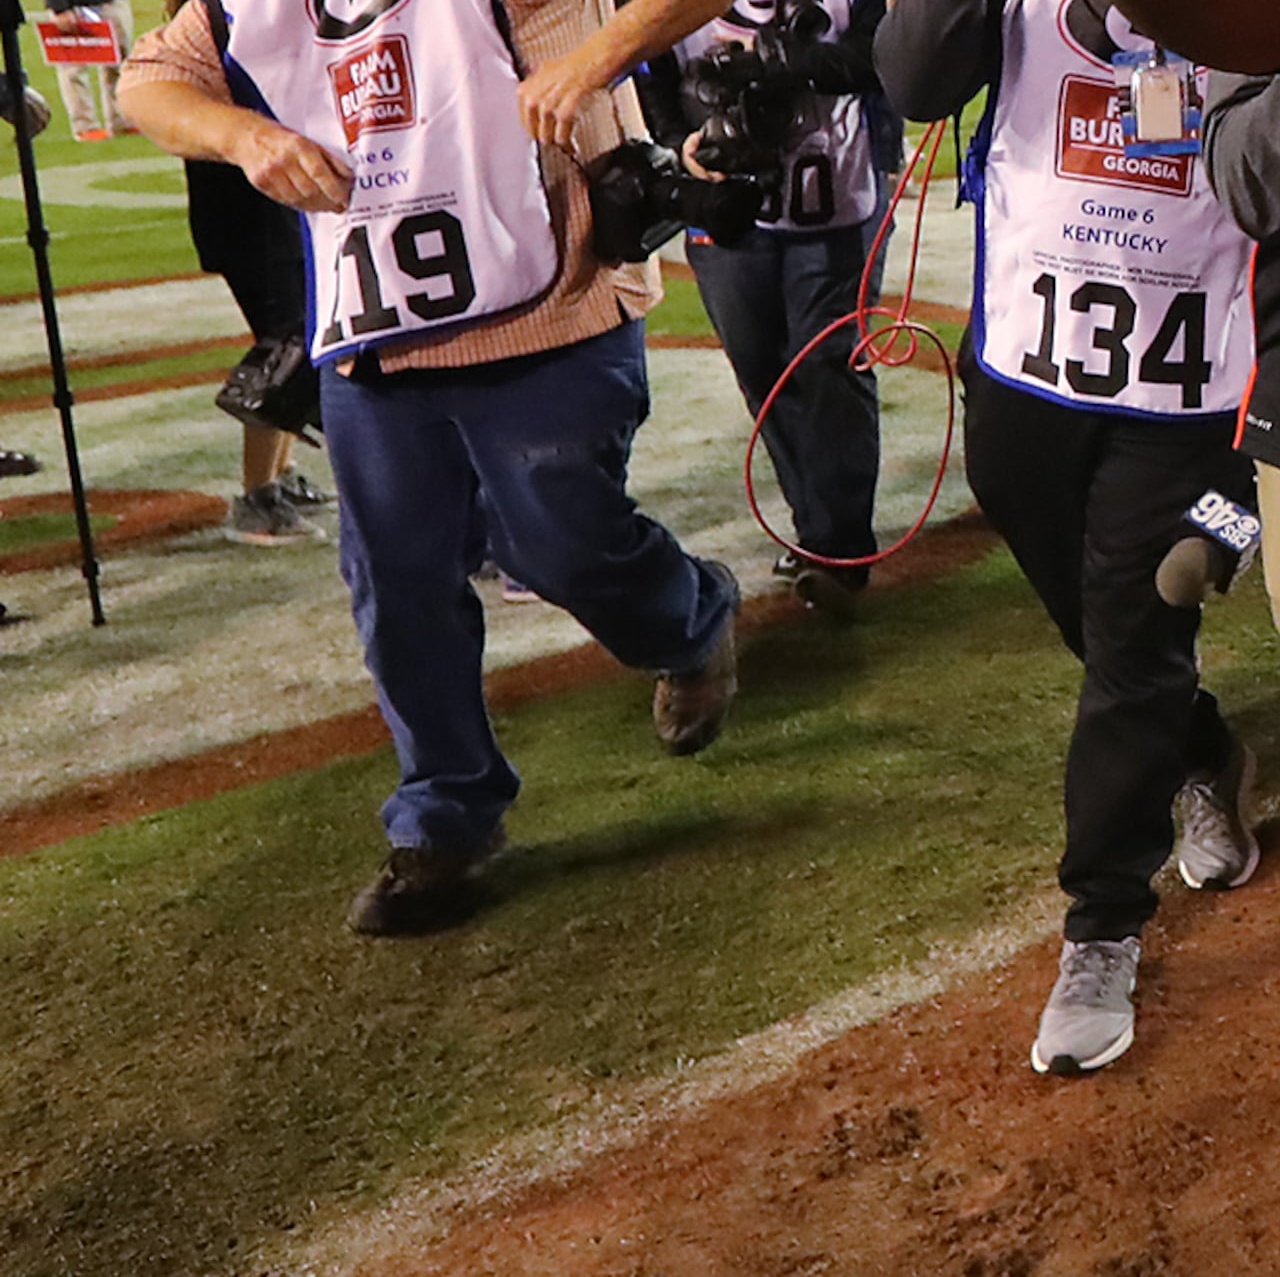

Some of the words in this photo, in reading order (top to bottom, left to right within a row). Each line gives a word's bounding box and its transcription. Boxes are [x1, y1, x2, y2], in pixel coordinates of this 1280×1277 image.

[382, 147, 394, 162] 6
[1103, 155, 1180, 181] GEORGIA
[1081, 199, 1138, 221] Game
[1142, 208, 1155, 224] 6
[1063, 223, 1168, 254] KENTUCKY
[1022, 273, 1212, 408] 134
